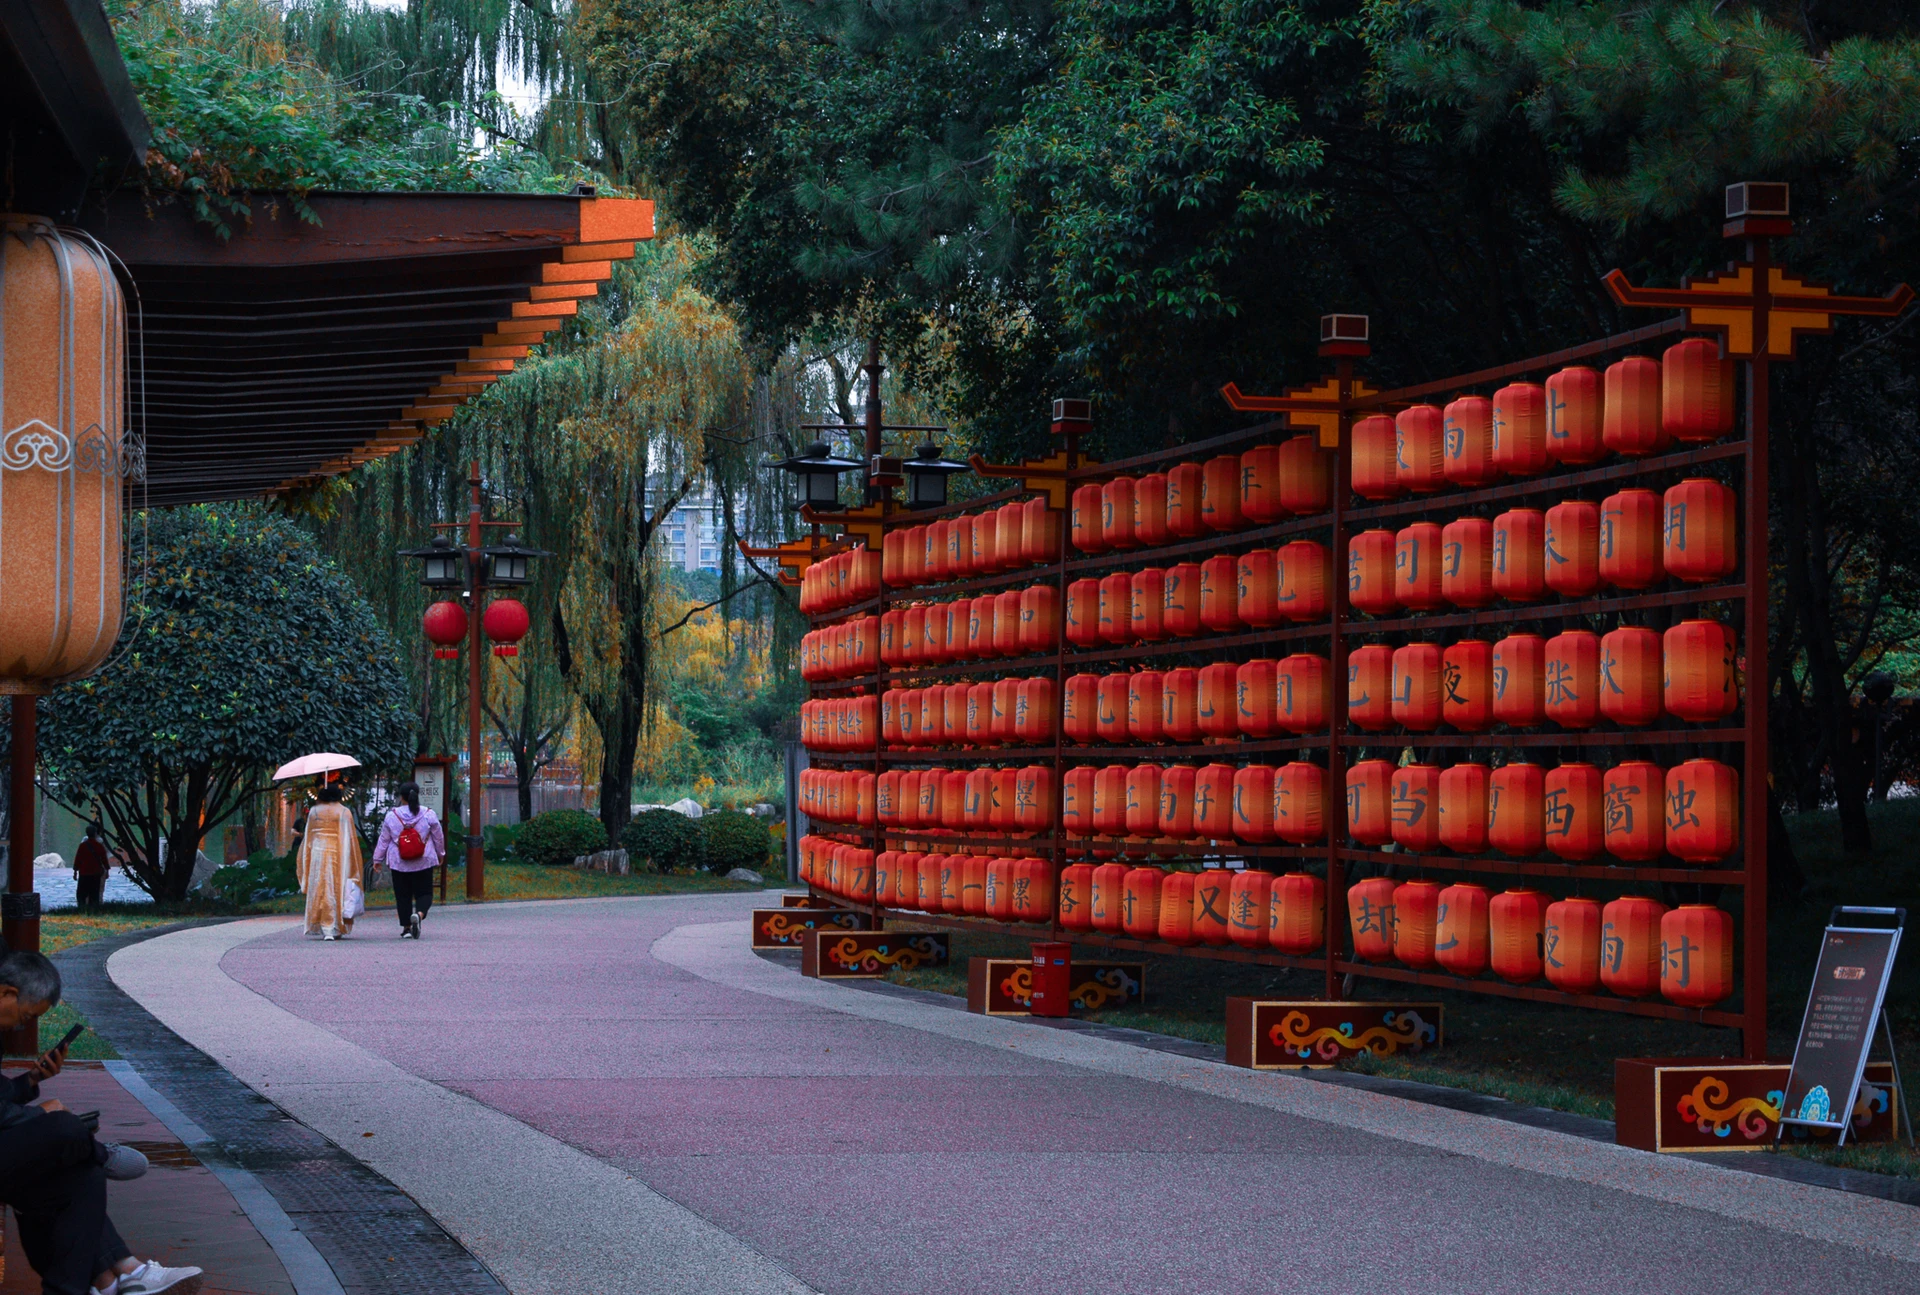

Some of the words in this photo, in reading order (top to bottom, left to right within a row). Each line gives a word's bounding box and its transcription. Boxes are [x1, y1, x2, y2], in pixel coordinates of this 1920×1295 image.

[1391, 664, 1413, 706] 山
[1443, 661, 1470, 705] 夜
[1391, 781, 1429, 827] 当
[1545, 787, 1575, 837] 西
[1603, 782, 1641, 835] 窗
[1196, 885, 1229, 926] 又
[1230, 890, 1262, 930] 逢
[1356, 896, 1397, 944] 却
